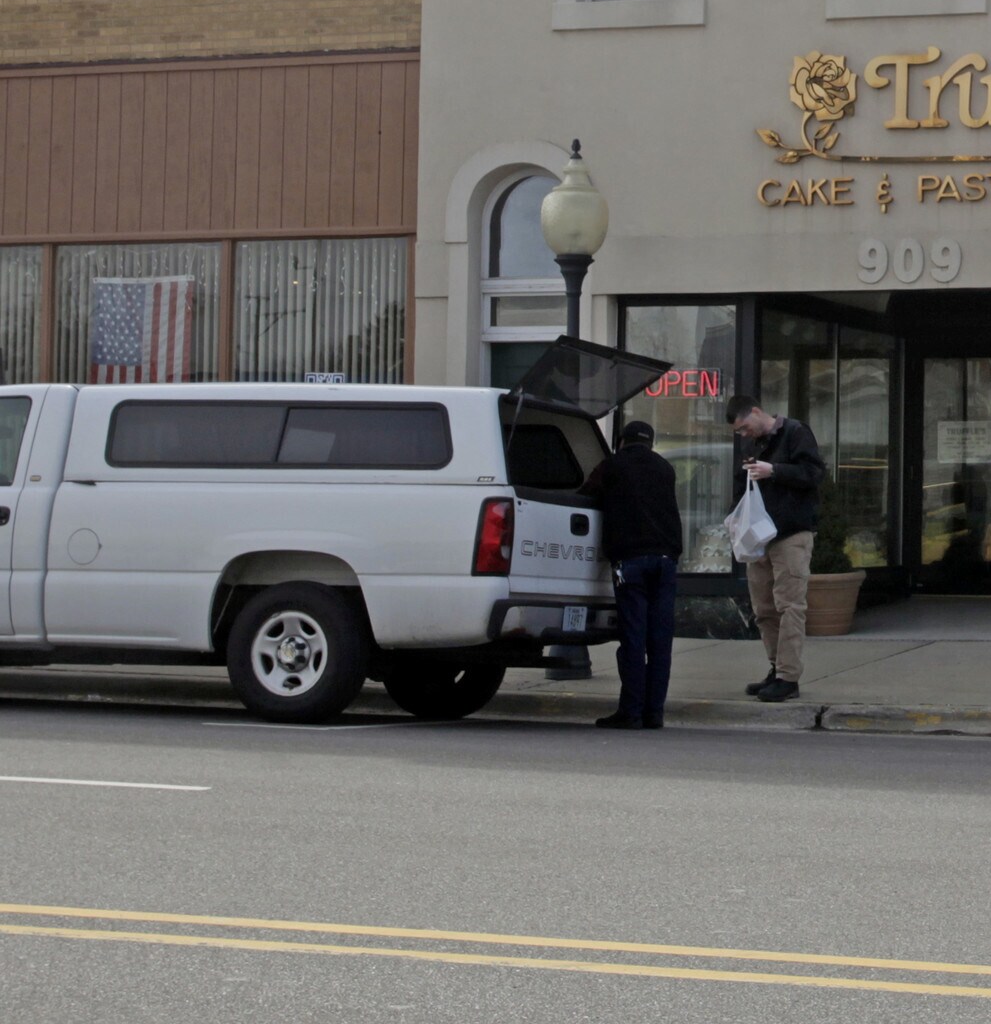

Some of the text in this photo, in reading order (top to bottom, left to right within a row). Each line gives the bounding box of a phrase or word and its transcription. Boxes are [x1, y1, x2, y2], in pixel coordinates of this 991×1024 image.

[757, 176, 855, 207] CAKE
[876, 173, 893, 214] &
[857, 238, 962, 284] 909
[645, 370, 718, 397] OPEN
